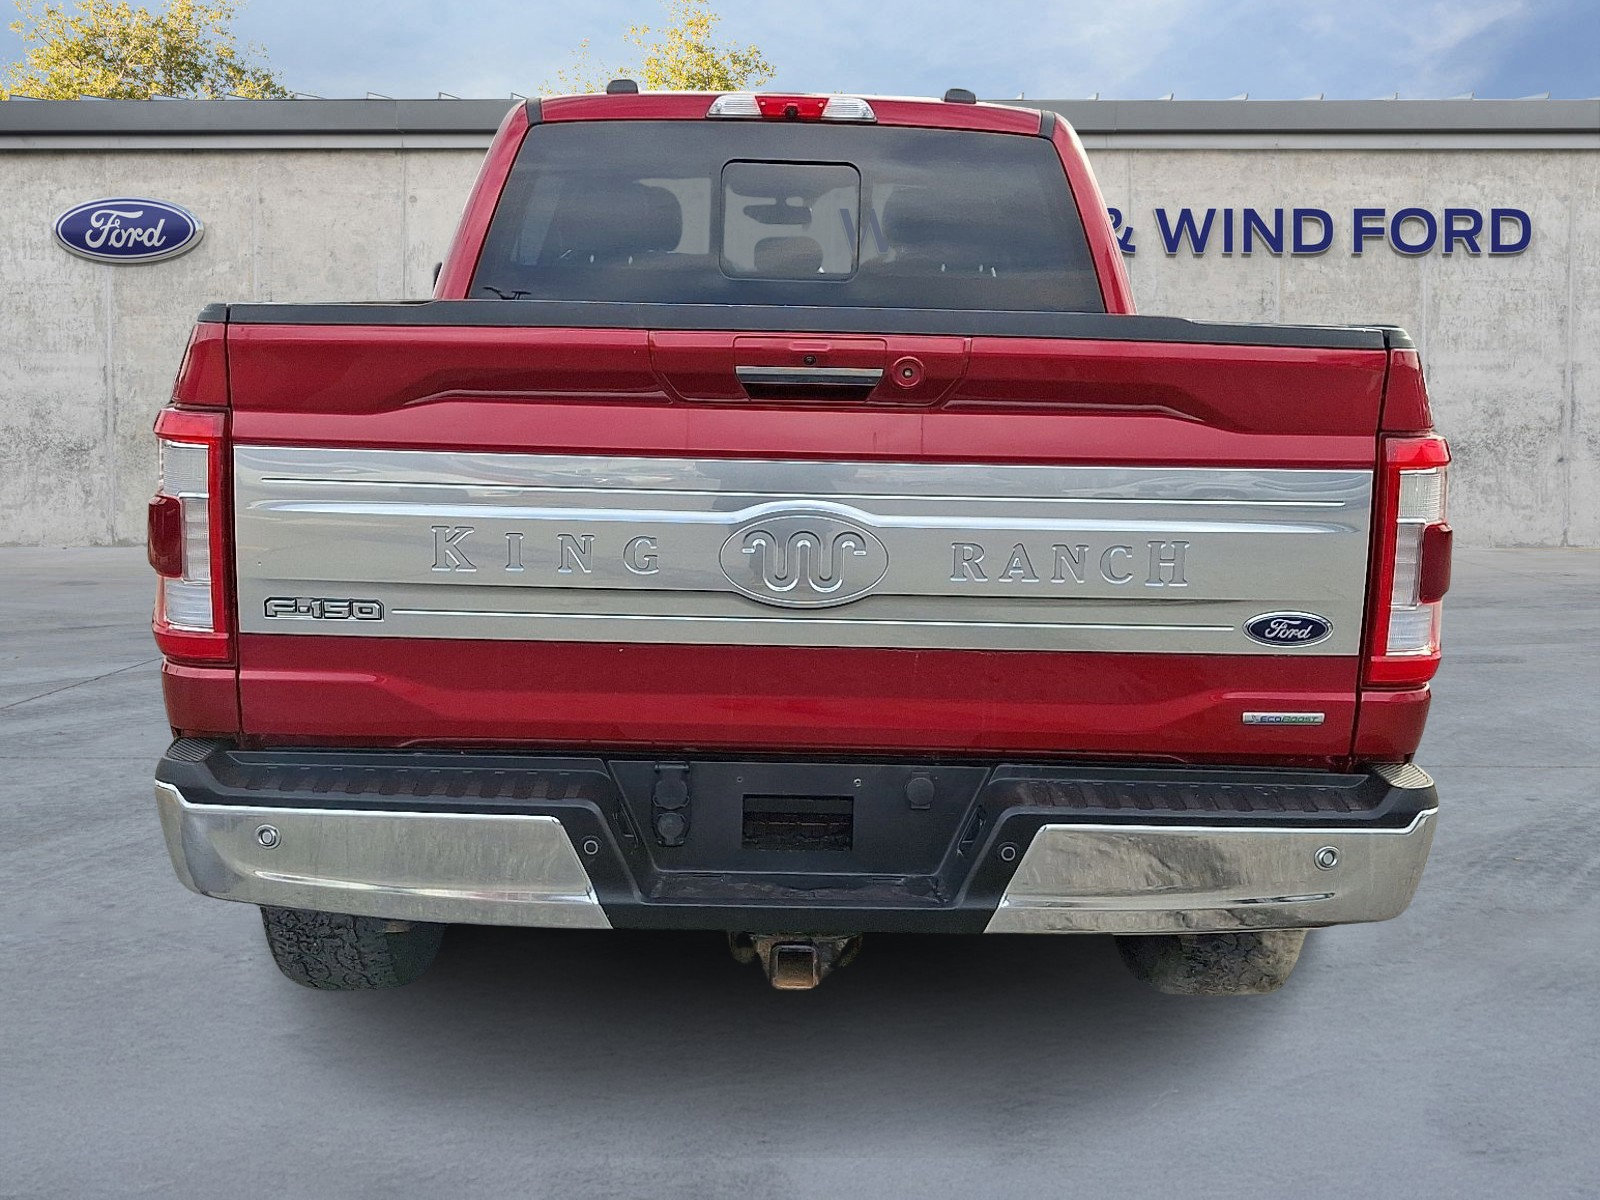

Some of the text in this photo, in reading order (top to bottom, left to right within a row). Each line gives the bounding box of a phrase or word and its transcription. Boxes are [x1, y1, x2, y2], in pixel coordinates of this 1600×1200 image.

[85, 209, 166, 249] Ford
[1153, 207, 1335, 256] WIND
[1351, 207, 1532, 256] FORD
[431, 525, 1190, 587] KING RANCH
[263, 596, 384, 622] F-150
[1264, 618, 1312, 639] Ford
